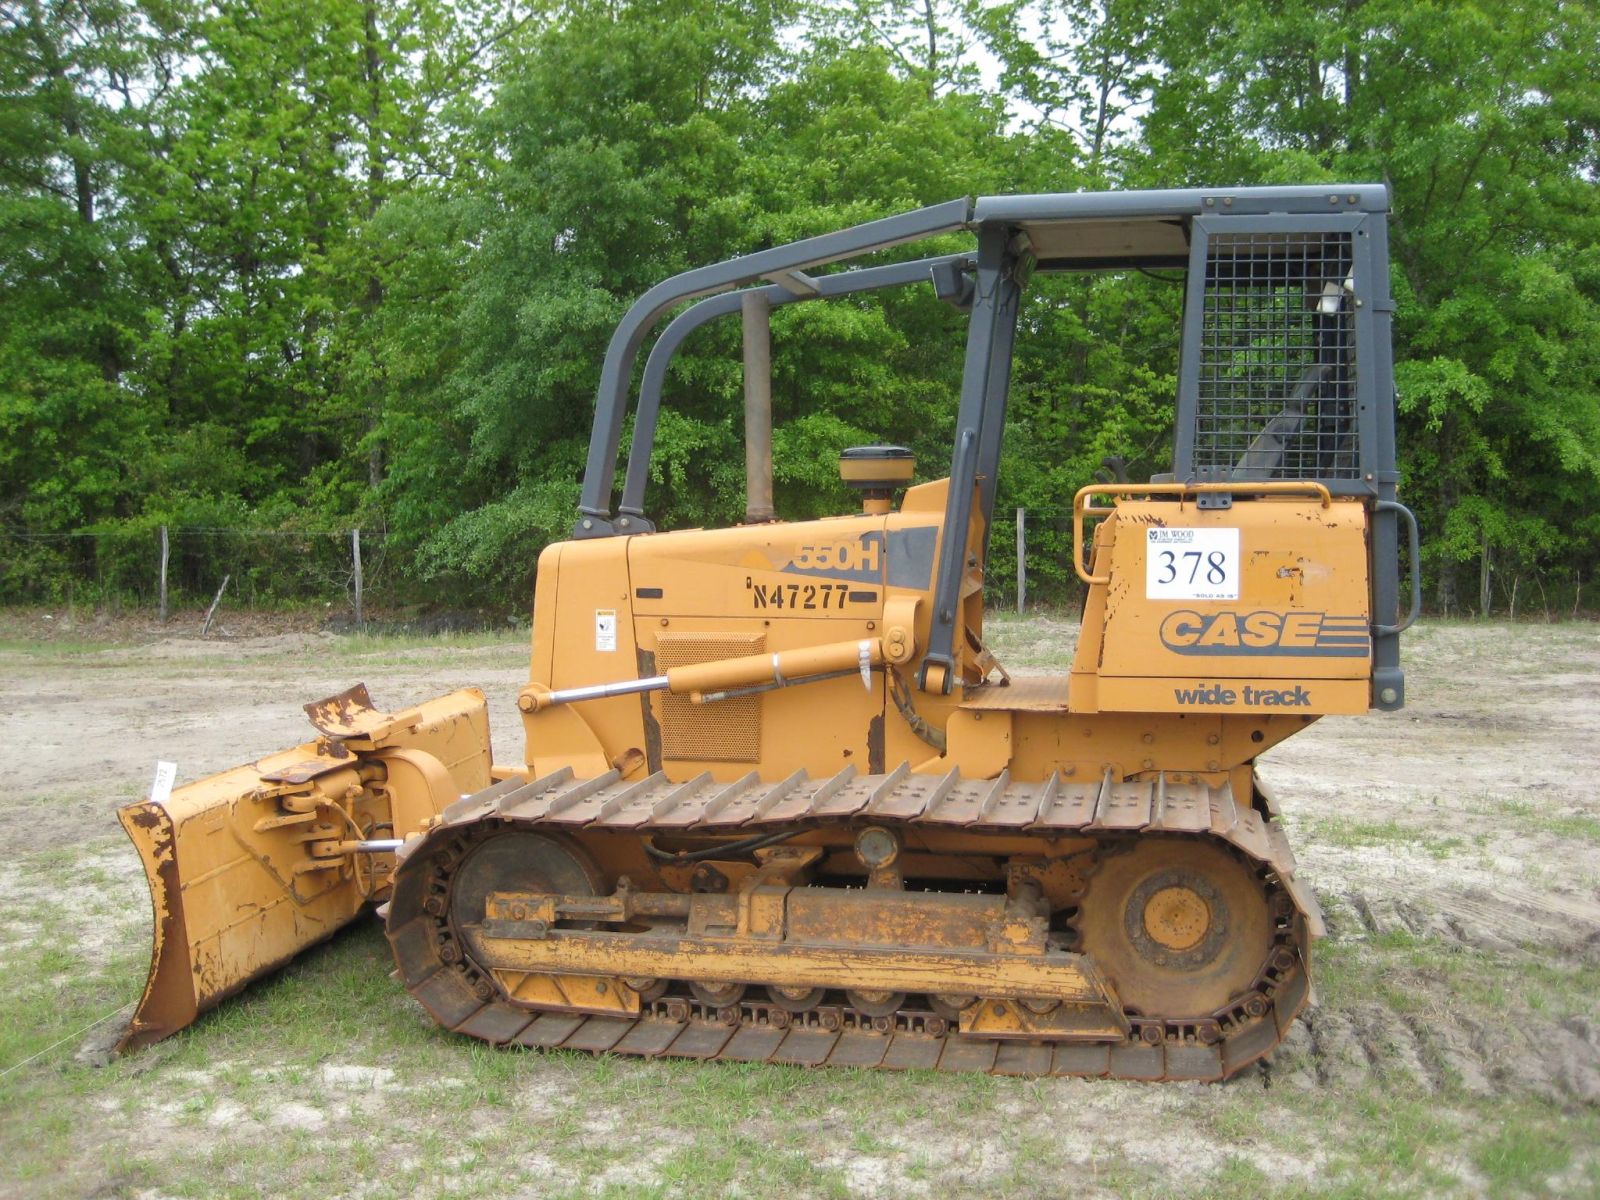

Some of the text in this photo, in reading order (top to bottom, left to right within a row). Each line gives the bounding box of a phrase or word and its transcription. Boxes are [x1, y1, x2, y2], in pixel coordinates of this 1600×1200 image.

[1171, 530, 1194, 538] WOOD
[794, 540, 879, 571] 550H
[1158, 550, 1226, 585] 378
[753, 584, 849, 609] N47277
[1160, 609, 1326, 648] CASE
[1174, 684, 1312, 706] wide track
